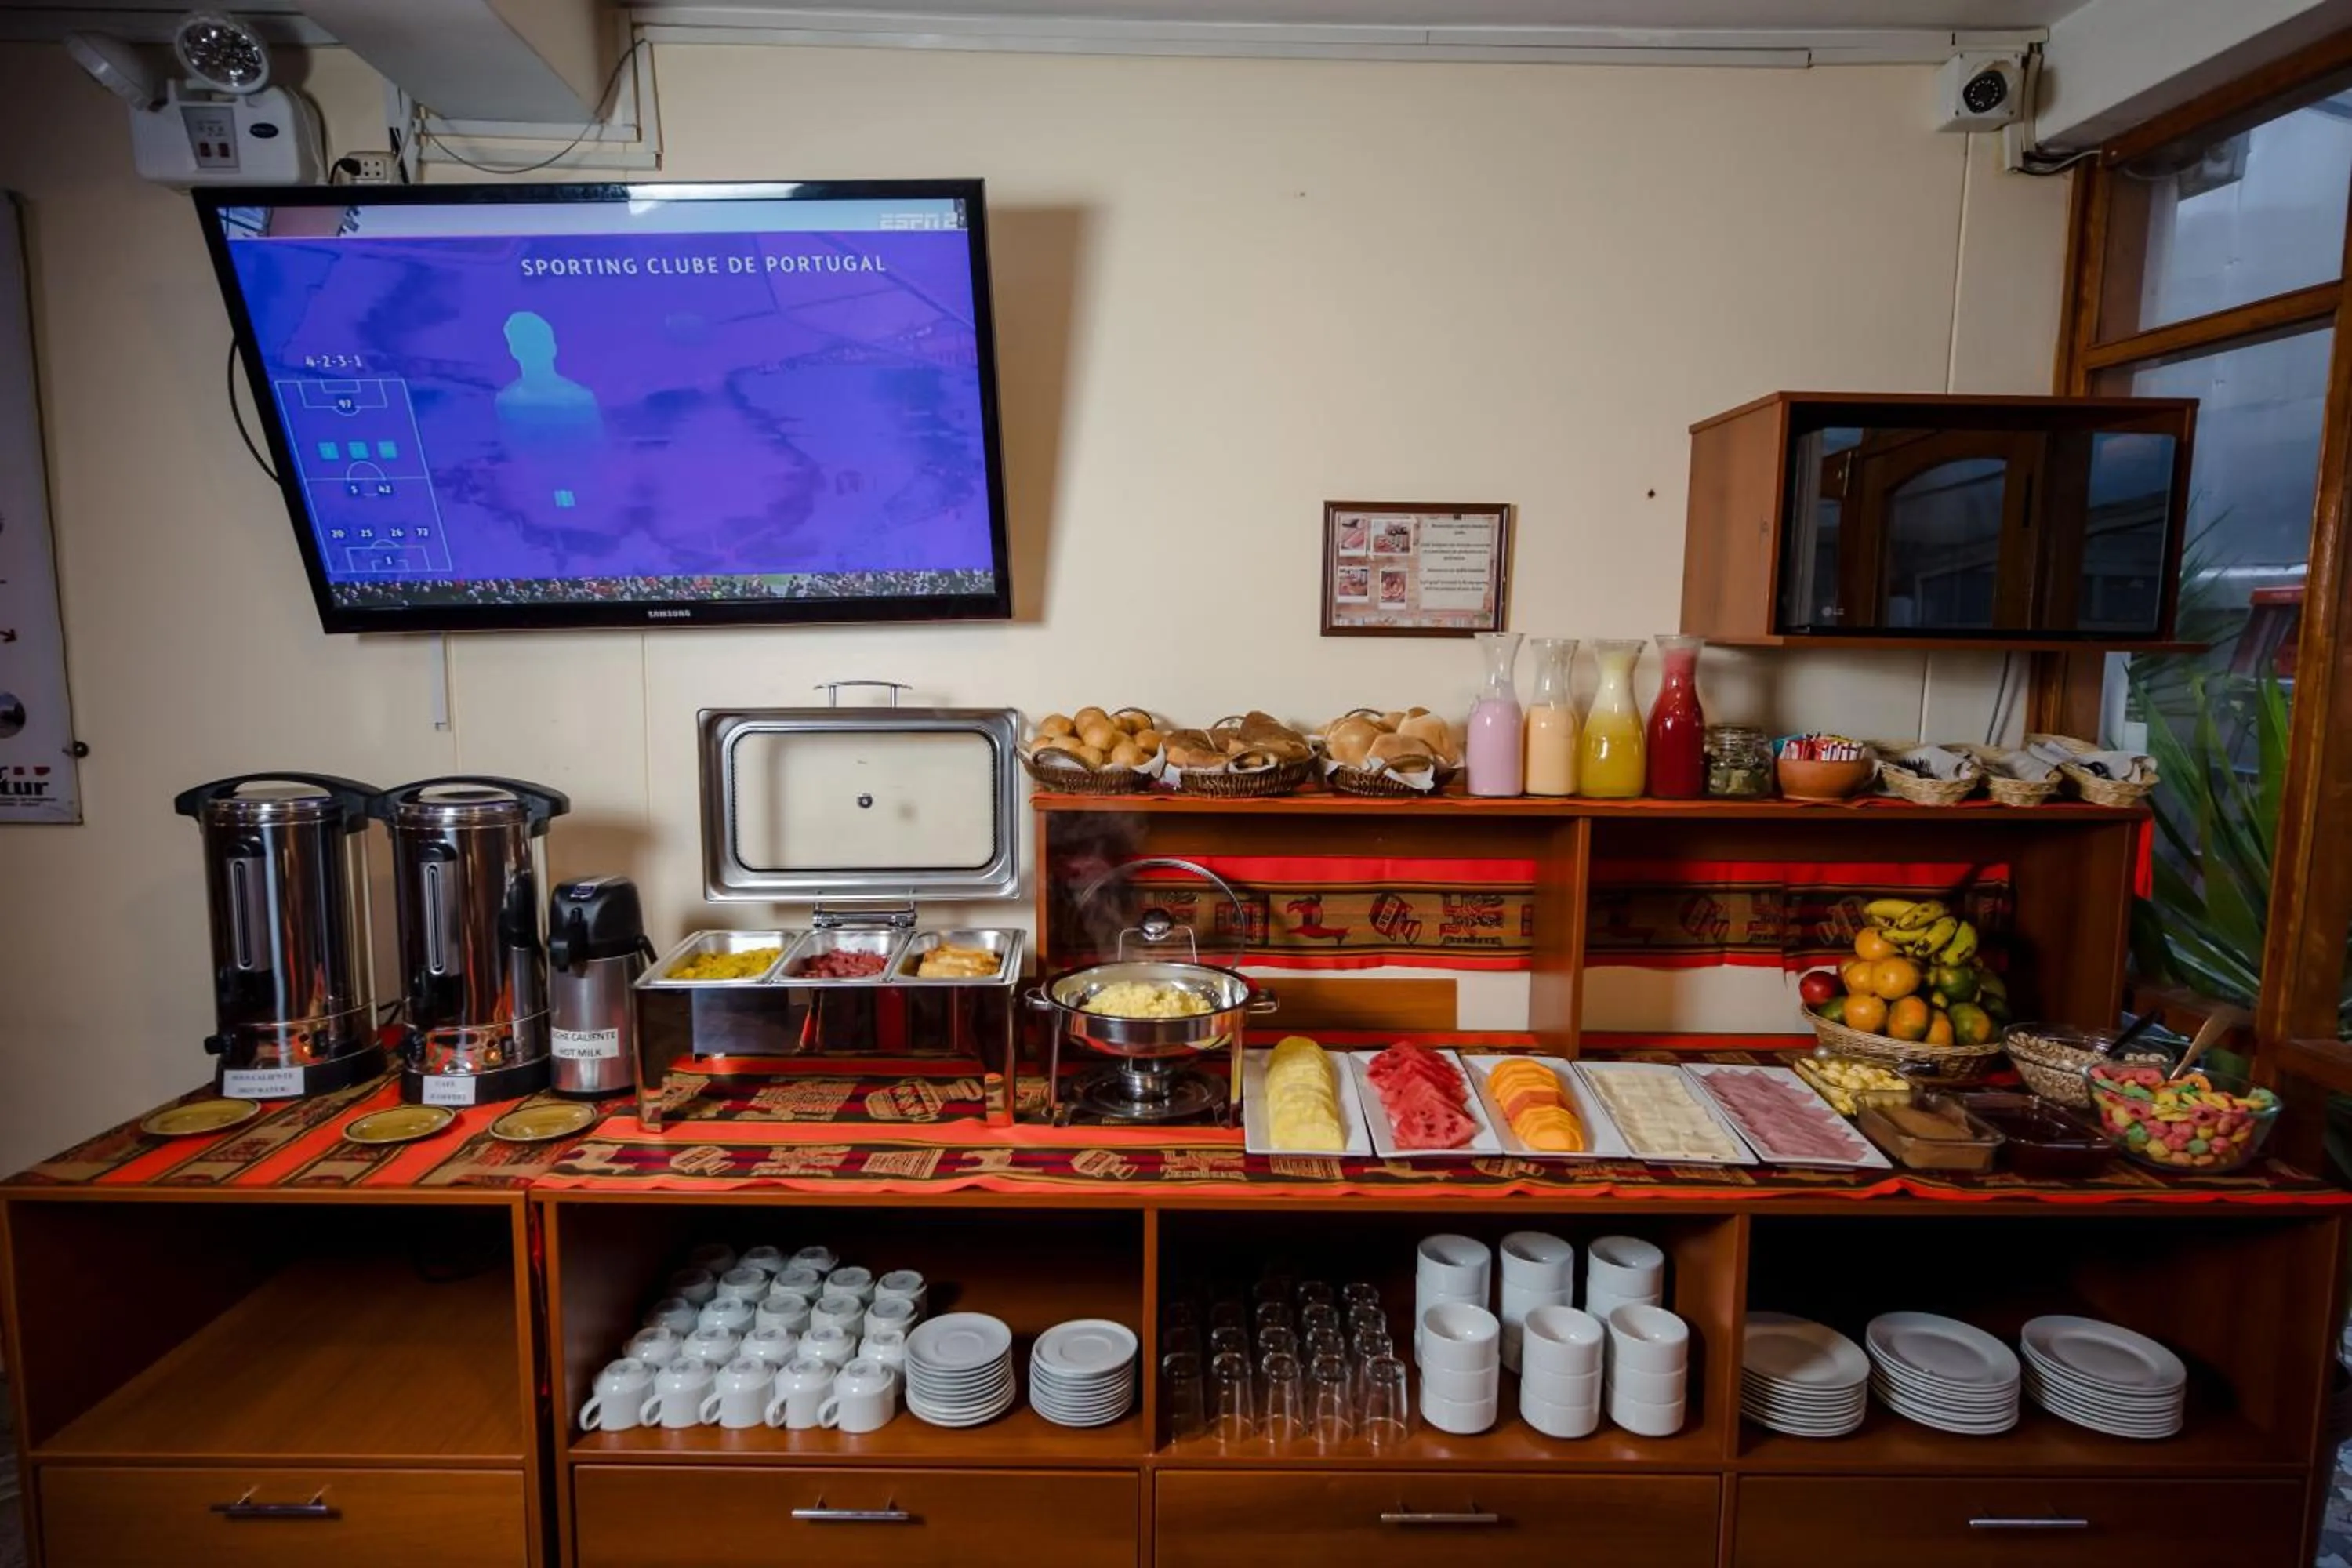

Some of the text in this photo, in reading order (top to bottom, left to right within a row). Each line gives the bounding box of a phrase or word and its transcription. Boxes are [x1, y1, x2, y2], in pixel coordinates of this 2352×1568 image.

[521, 255, 886, 276] SPORTING CLUBE DE PORTUGAL
[304, 354, 363, 368] 4-2-3-1
[648, 609, 691, 618] SAMSUNG
[572, 1031, 615, 1041] CALIENTE
[577, 1048, 602, 1058] MILK
